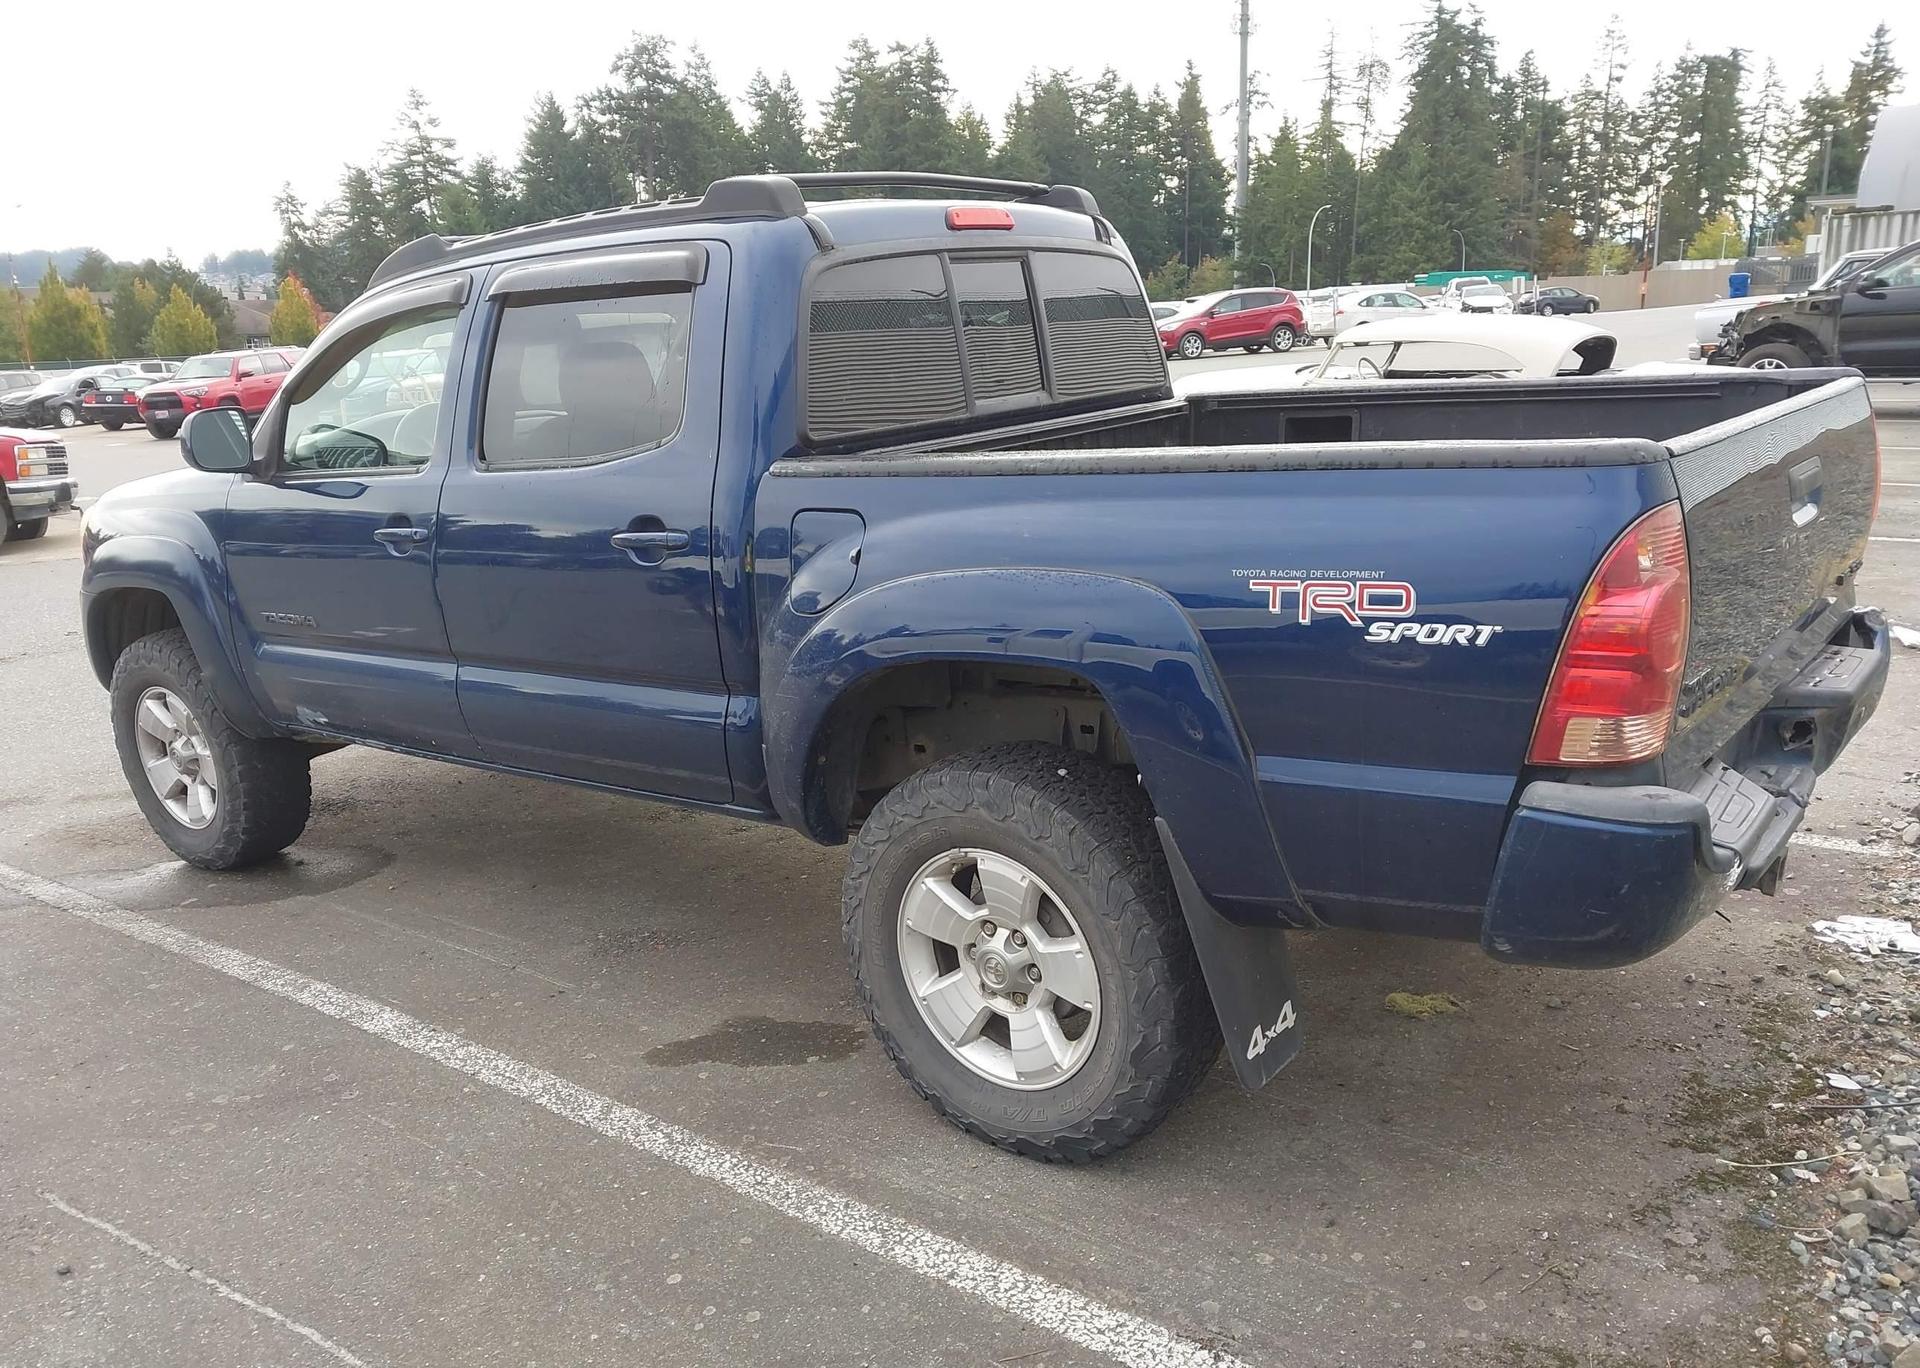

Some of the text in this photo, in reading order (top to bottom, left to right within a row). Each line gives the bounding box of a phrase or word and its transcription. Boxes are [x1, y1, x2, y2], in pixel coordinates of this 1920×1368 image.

[1231, 569, 1386, 579] TOYOTA RACING DEVELOPMENT
[1249, 579, 1417, 628] TRD
[1363, 621, 1504, 647] SPORT
